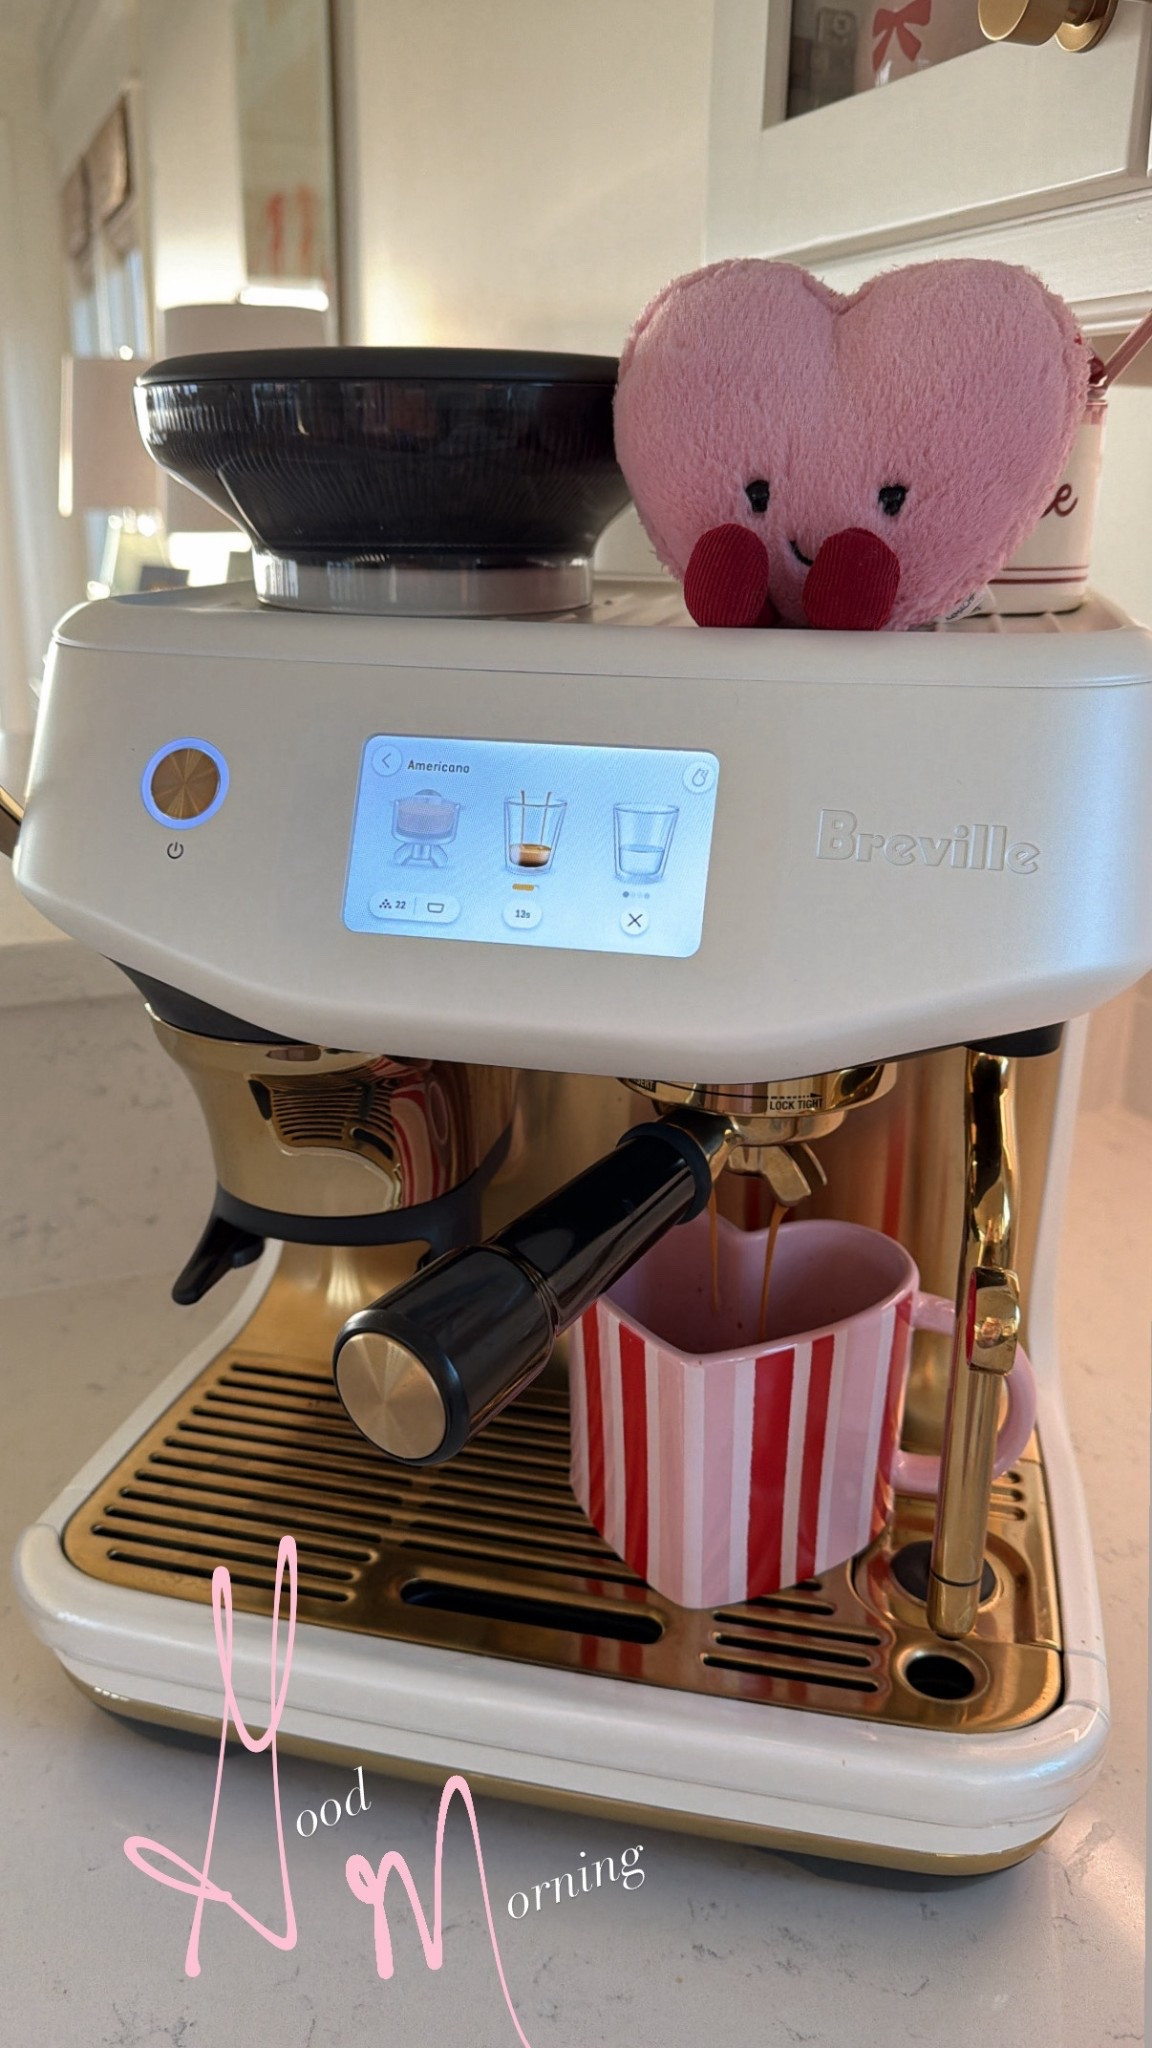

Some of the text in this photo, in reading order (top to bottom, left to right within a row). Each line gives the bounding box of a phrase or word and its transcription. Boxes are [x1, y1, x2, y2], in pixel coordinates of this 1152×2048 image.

[407, 759, 470, 774] Americano
[816, 808, 1040, 875] Breville
[395, 900, 407, 910] 22
[769, 1098, 823, 1110] LOCK TIGHT
